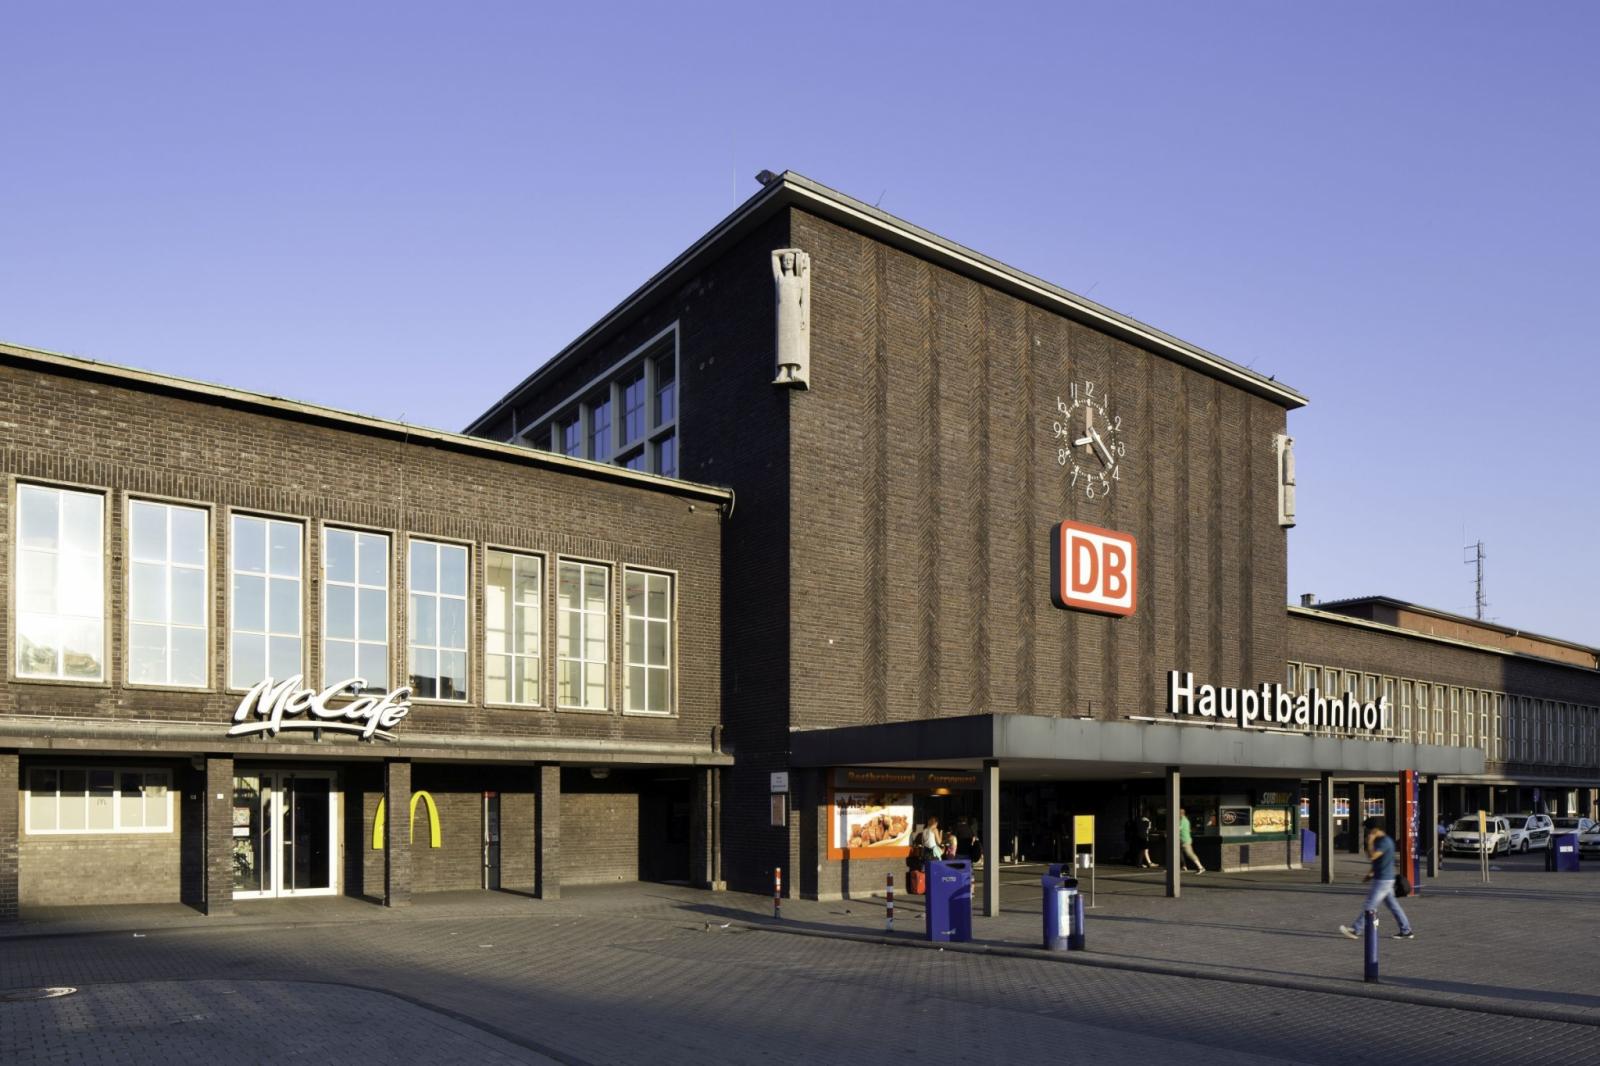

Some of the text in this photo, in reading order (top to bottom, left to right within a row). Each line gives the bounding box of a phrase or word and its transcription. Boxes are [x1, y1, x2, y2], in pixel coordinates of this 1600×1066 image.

[1070, 382, 1078, 402] 11
[1086, 381, 1094, 398] 12
[1057, 396, 1067, 413] 10
[1104, 393, 1108, 409] 1
[1053, 421, 1062, 438] 9
[1114, 415, 1122, 432] 2
[1057, 448, 1066, 465] 8
[1117, 441, 1126, 457] 3
[1070, 468, 1079, 487] 7
[1112, 465, 1121, 480] 4
[1086, 483, 1095, 498] 6
[1102, 480, 1110, 495] 5
[1071, 535, 1127, 600] DB
[232, 674, 413, 738] McCafé
[1168, 670, 1387, 731] Hauptbahnhof
